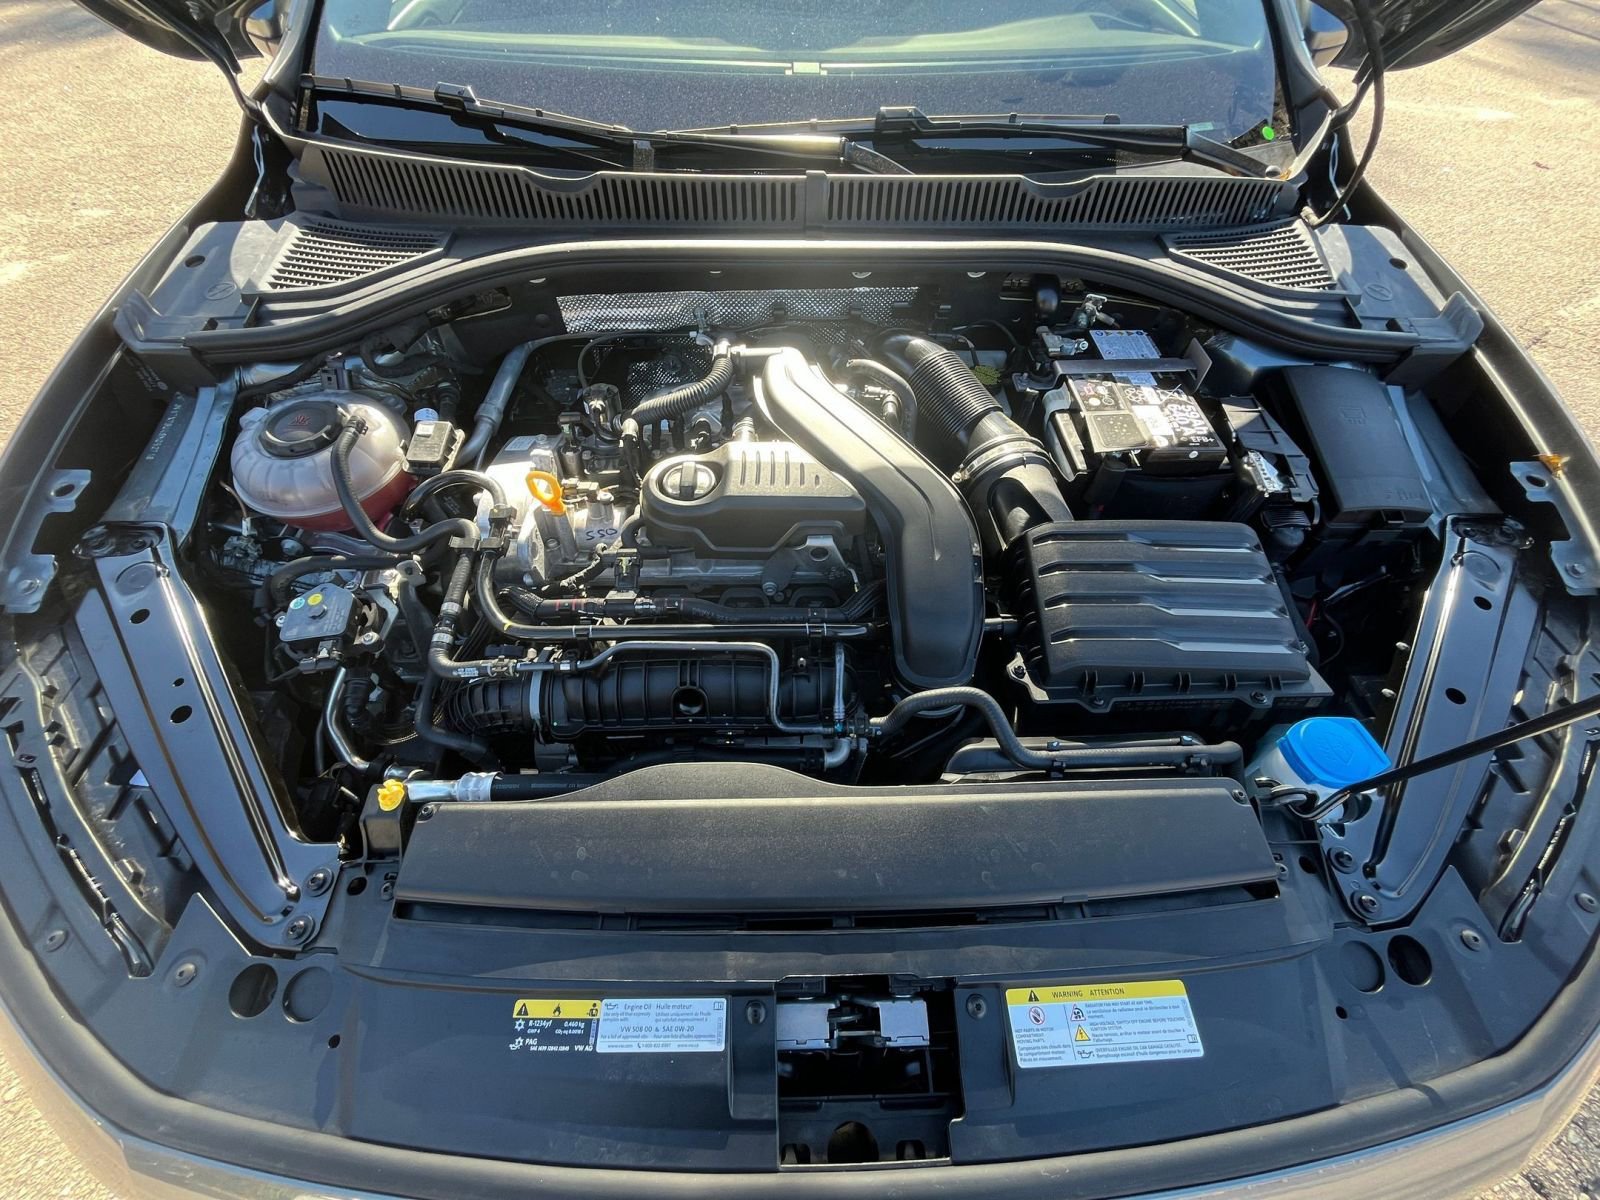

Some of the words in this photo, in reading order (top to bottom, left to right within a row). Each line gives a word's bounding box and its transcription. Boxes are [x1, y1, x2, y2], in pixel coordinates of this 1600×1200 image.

[1052, 990, 1083, 999] WARNING
[1089, 988, 1125, 997] ATTENTION
[624, 1003, 643, 1011] Engine
[525, 1038, 538, 1046] PAG
